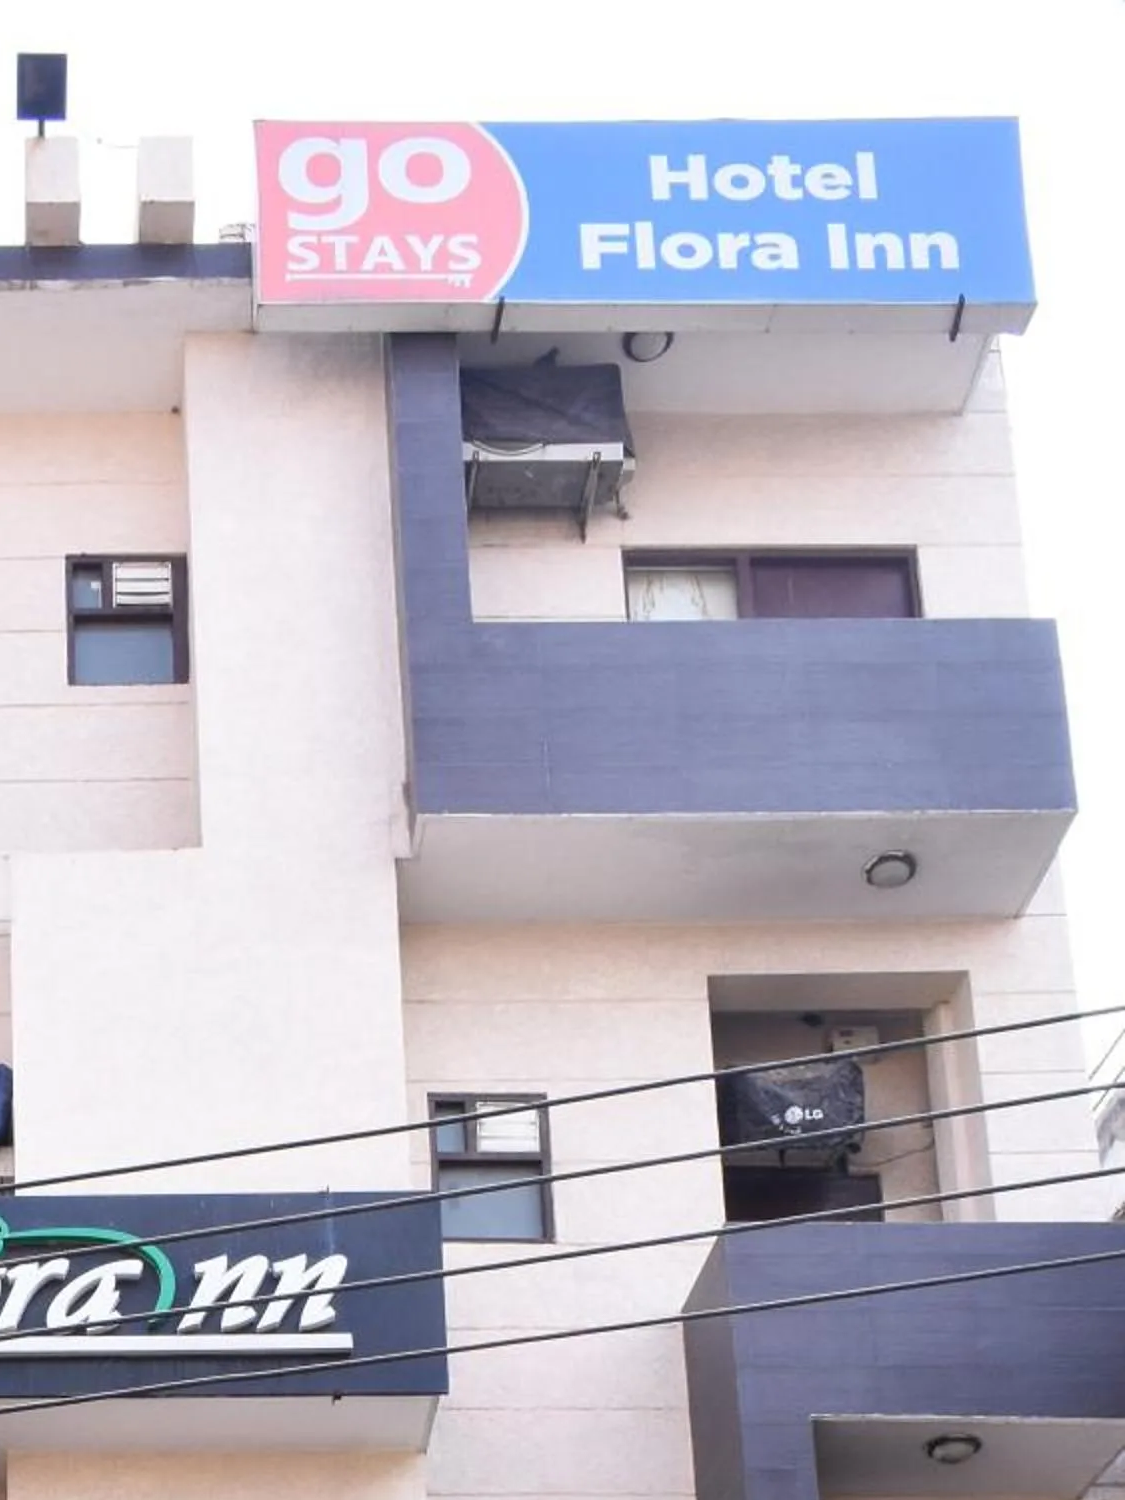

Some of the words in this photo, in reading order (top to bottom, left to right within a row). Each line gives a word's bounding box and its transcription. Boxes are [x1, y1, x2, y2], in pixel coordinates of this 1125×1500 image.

[278, 136, 471, 231] go
[649, 151, 878, 201] Hotel
[286, 234, 482, 271] STAYS
[580, 220, 800, 269] Flora
[827, 223, 960, 269] Inn
[805, 1109, 824, 1120] LG
